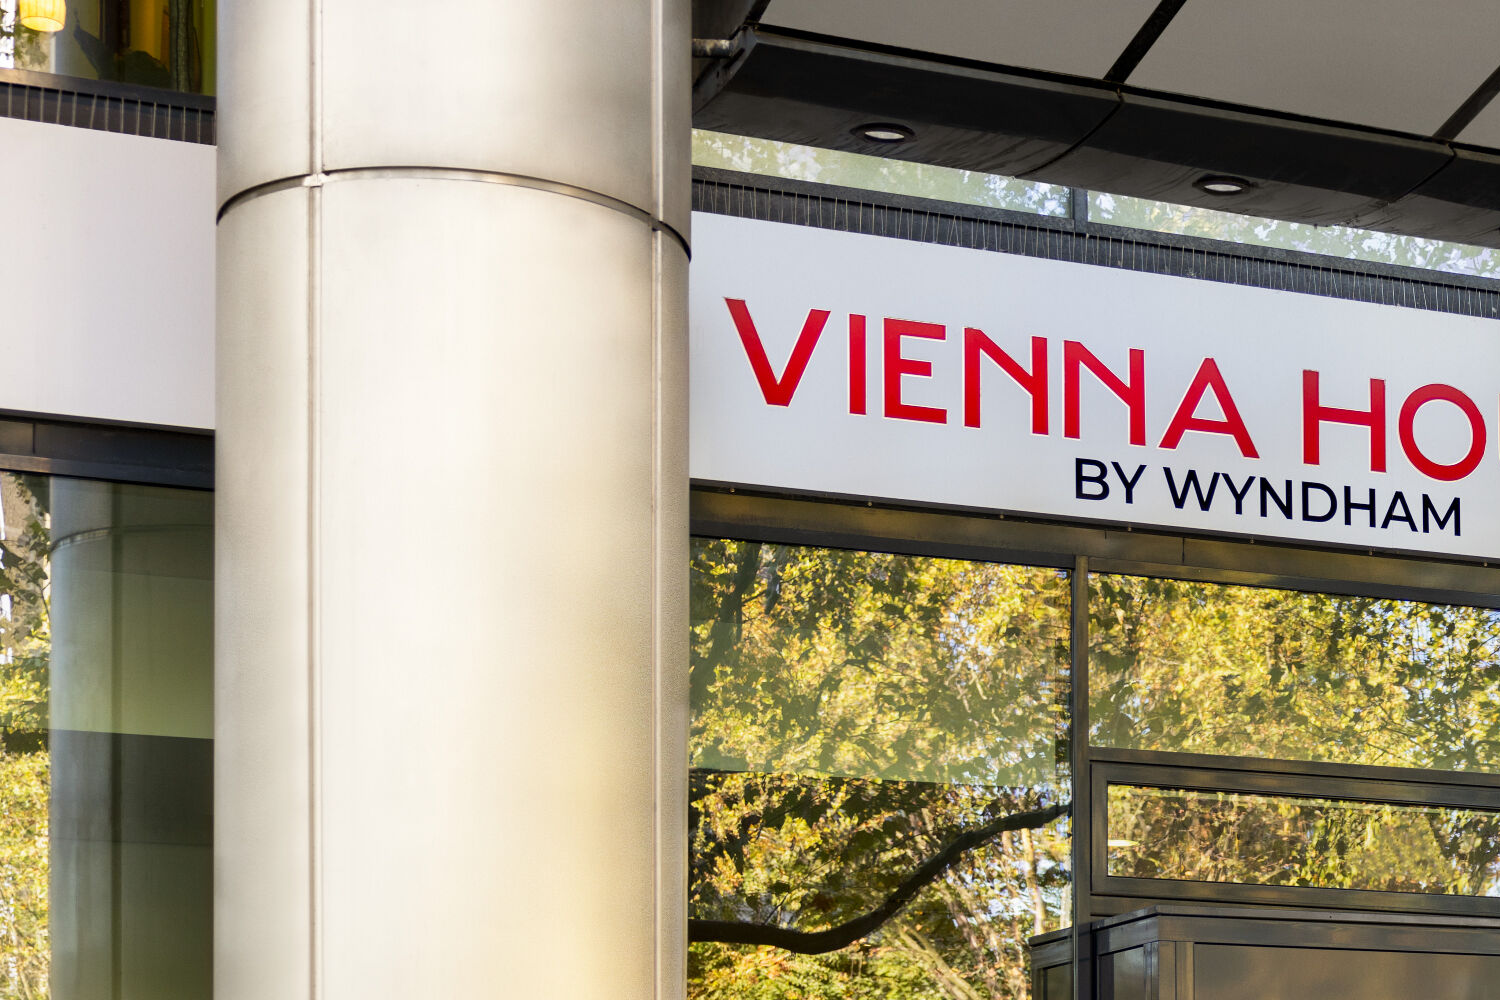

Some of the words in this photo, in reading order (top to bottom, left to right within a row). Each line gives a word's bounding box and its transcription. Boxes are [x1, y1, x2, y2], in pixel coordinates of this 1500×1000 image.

[725, 298, 1260, 459] VIENNA
[1075, 457, 1147, 504] BY
[1162, 466, 1461, 537] WYNDHAM
